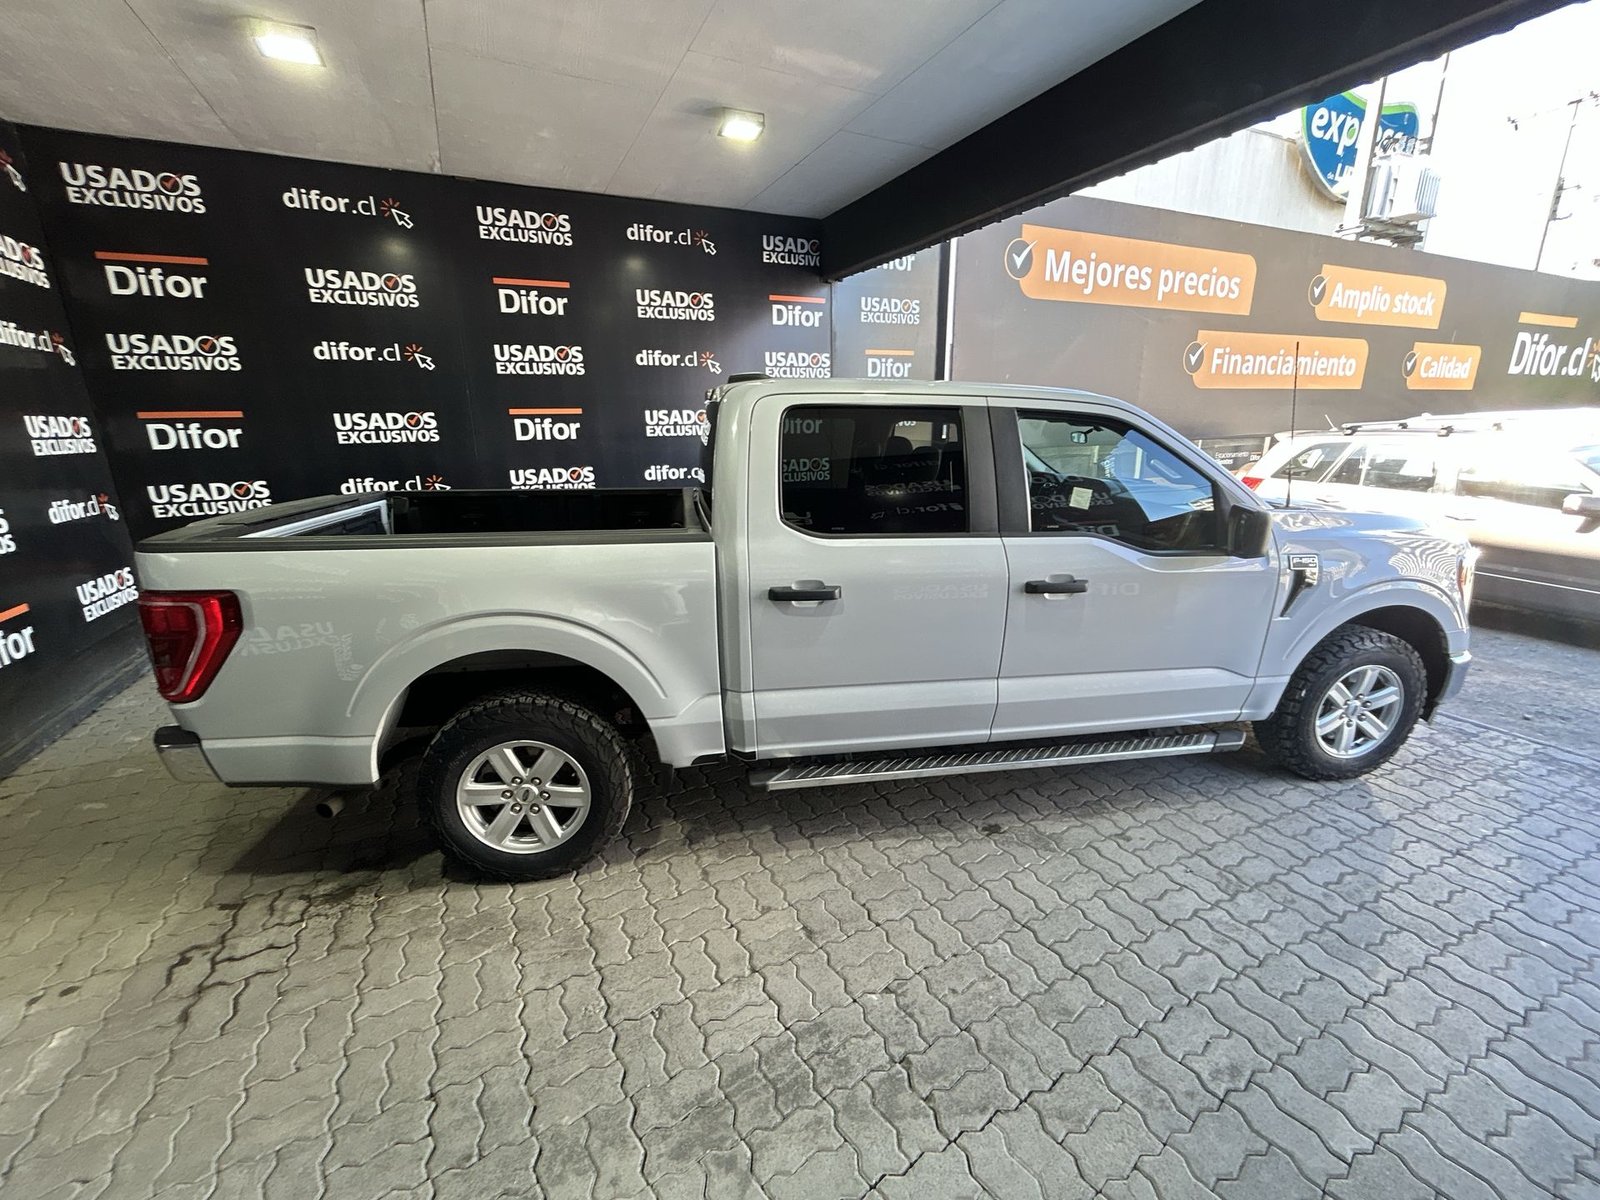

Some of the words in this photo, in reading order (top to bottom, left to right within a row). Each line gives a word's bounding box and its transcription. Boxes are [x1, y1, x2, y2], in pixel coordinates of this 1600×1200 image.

[59, 161, 201, 197] USADOS
[66, 186, 206, 214] EXCLUSIVOS
[282, 187, 376, 216] difor.cl
[475, 206, 571, 232] USADOS
[478, 226, 573, 246] EXCLUSIVOS
[626, 224, 691, 245] difor.cl
[763, 235, 820, 255] USADO
[763, 252, 820, 267] EXCLUSIV
[104, 265, 208, 298] Difor
[305, 267, 417, 293] USADOS
[1044, 248, 1152, 295] Mejores
[1157, 267, 1241, 301] precios
[309, 288, 419, 308] EXCLUSIVOS
[498, 289, 568, 316] Difor
[635, 289, 714, 309] USADOS
[861, 297, 920, 314] USADOS
[1329, 282, 1390, 318] Amplio
[1392, 290, 1435, 317] stock
[637, 306, 715, 321] EXCLUSIVOS
[772, 304, 823, 327] Difor
[861, 312, 920, 325] EXCLUSIVOS
[105, 333, 237, 357] USADOS
[313, 341, 401, 362] difor.cl
[493, 344, 584, 364] USADOS
[1507, 331, 1592, 376] Difor.cl
[111, 354, 242, 371] EXCLUSIVOS
[496, 361, 585, 375] EXCLUSIVOS
[635, 350, 697, 367] difor.cl
[765, 352, 830, 368] USADOS
[867, 358, 912, 378] Difor
[1211, 348, 1357, 377] Financiamiento
[1419, 356, 1472, 379] Calidad
[765, 366, 831, 378] EXCLUSIVOS
[23, 415, 92, 438] USADOS
[333, 411, 437, 431] USADOS
[644, 409, 707, 425] USADO
[146, 423, 243, 450] Difor
[336, 429, 440, 444] EXCLUSIVOS
[513, 418, 581, 441] Difor
[646, 425, 704, 437] EXCLUSIV
[30, 438, 97, 456] EXCLUSIVOS
[509, 466, 595, 485] USADOS
[783, 470, 831, 482] CLUSIVOS
[147, 480, 271, 503] USADOS
[48, 495, 100, 524] difor.cl
[75, 567, 135, 605] USADOS
[82, 586, 139, 622] EXCLUSIVOS
[0, 626, 35, 668] for
